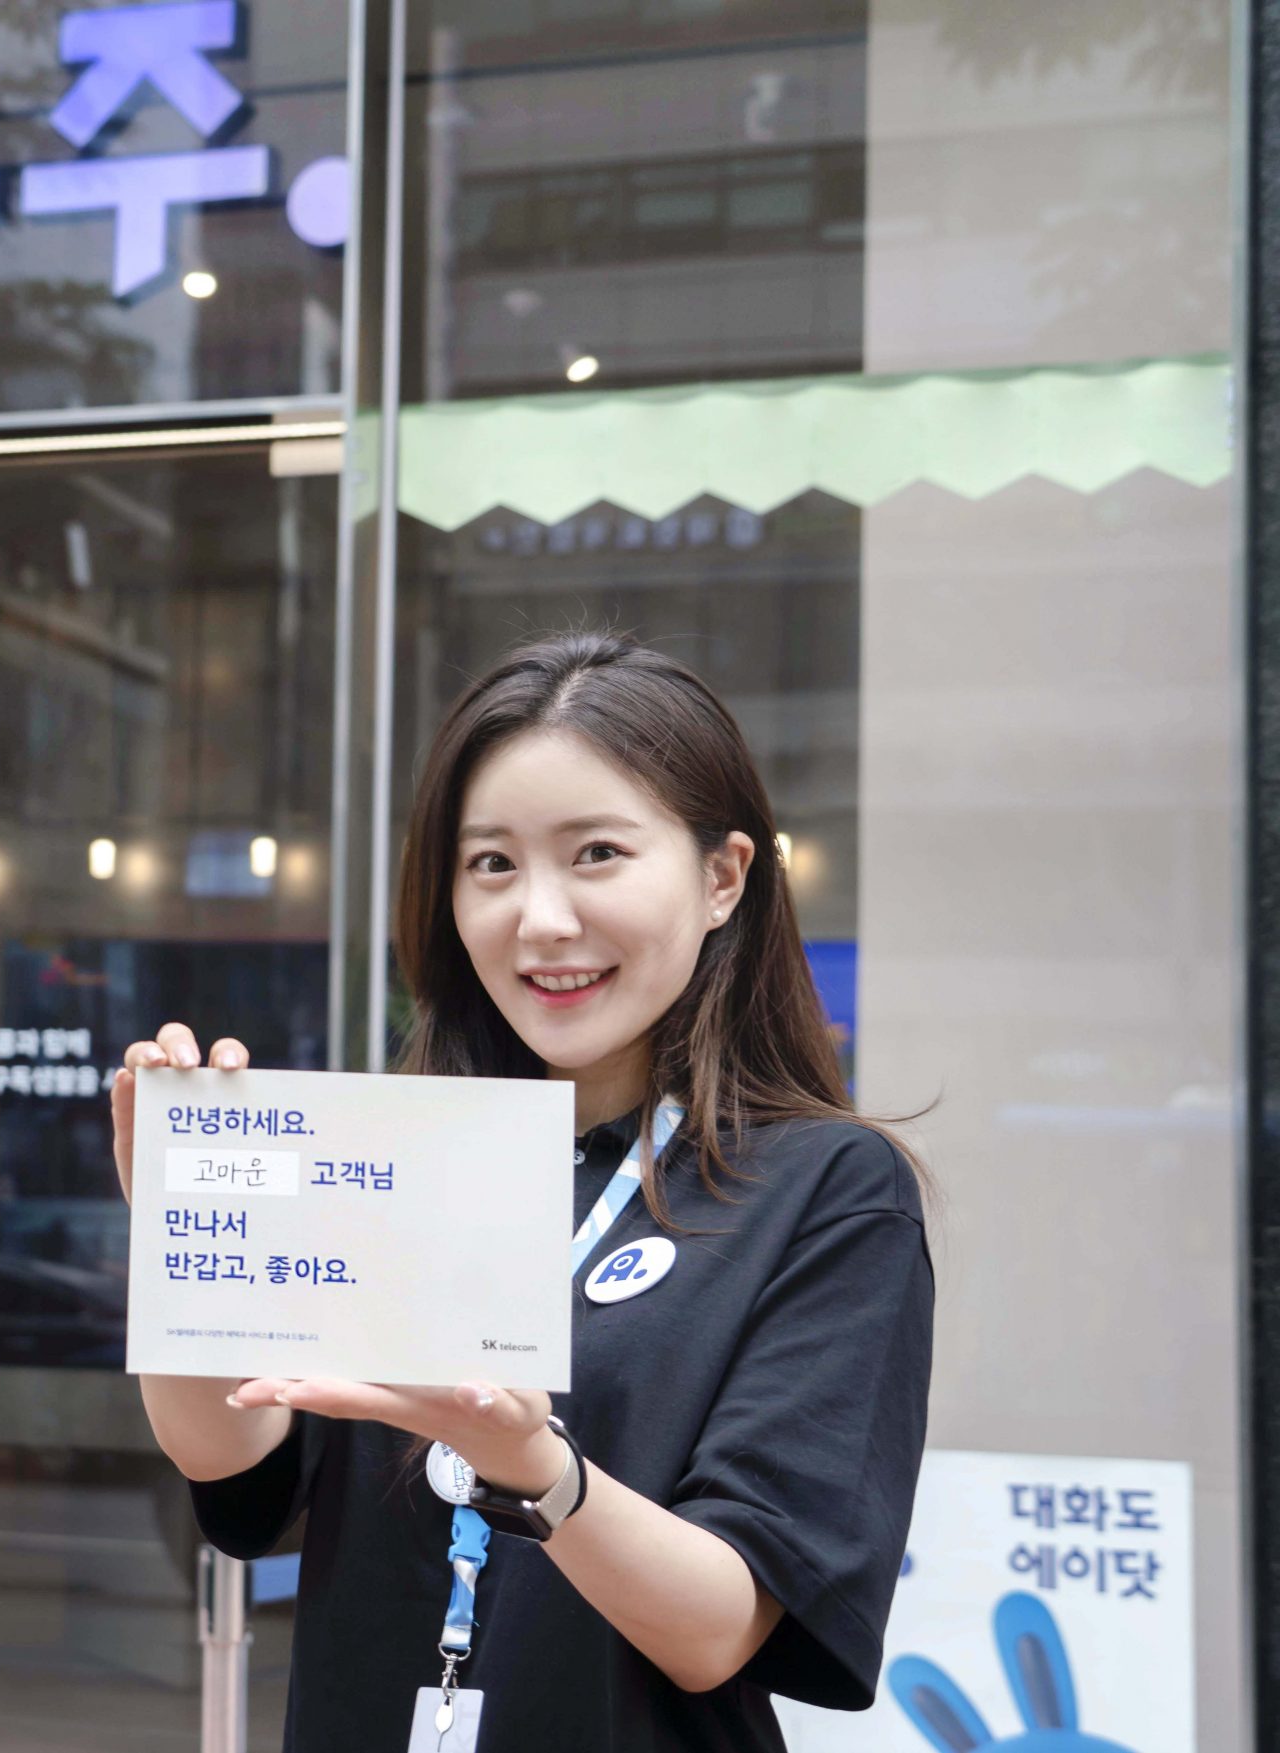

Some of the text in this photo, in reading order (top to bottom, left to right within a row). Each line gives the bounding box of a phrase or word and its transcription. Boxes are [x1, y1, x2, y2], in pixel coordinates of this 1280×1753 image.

[167, 1105, 315, 1137] 안녕하세요.
[193, 1157, 268, 1188] 고마운
[310, 1160, 394, 1191] 고객님
[165, 1209, 247, 1239] 만나서
[165, 1252, 357, 1286] 반갑고, 좋아요.
[481, 1338, 538, 1353] SK telecom
[1007, 1483, 1161, 1533] 대화도
[1008, 1542, 1162, 1600] 에이닷
